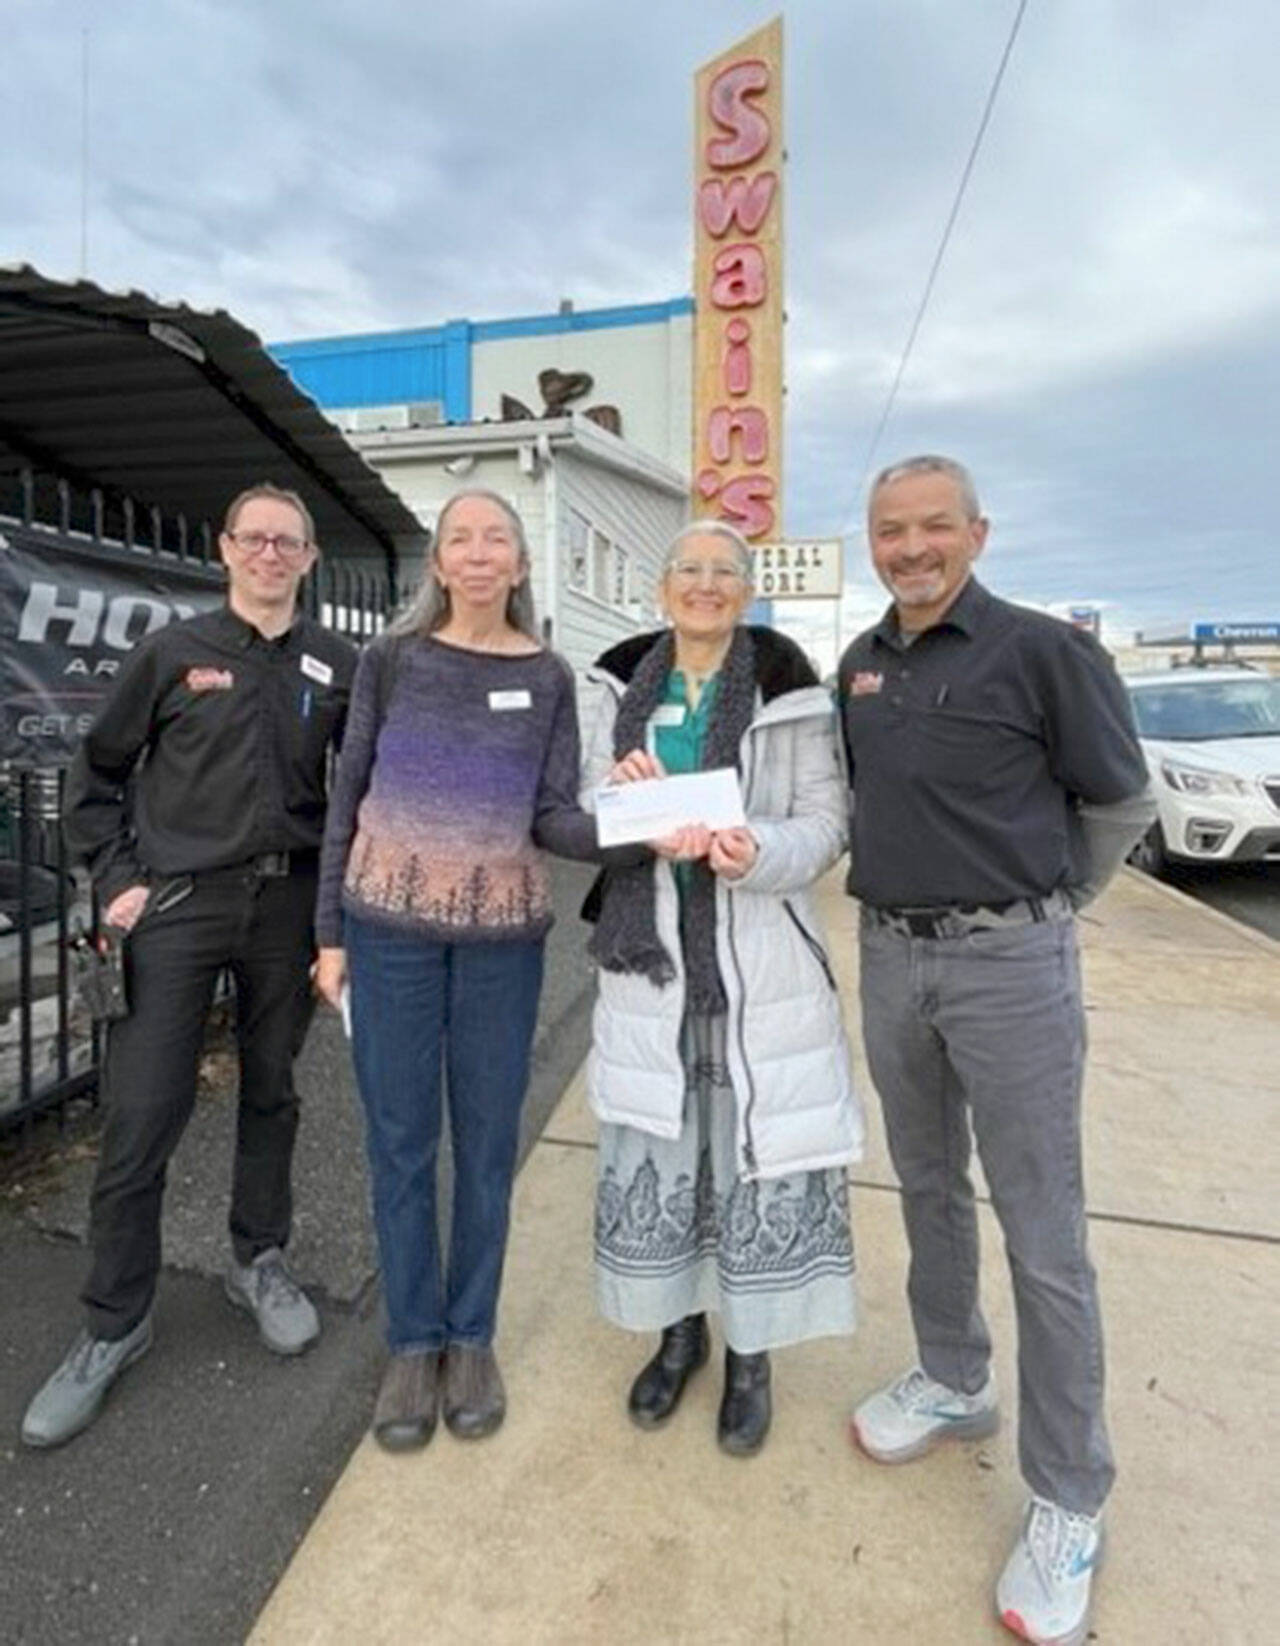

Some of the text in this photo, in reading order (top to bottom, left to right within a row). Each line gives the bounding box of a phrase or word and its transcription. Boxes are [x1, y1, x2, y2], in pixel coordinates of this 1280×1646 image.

[699, 60, 776, 539] Swain's
[751, 546, 822, 568] ERAL
[18, 582, 196, 650] HO
[17, 714, 74, 737] GET
